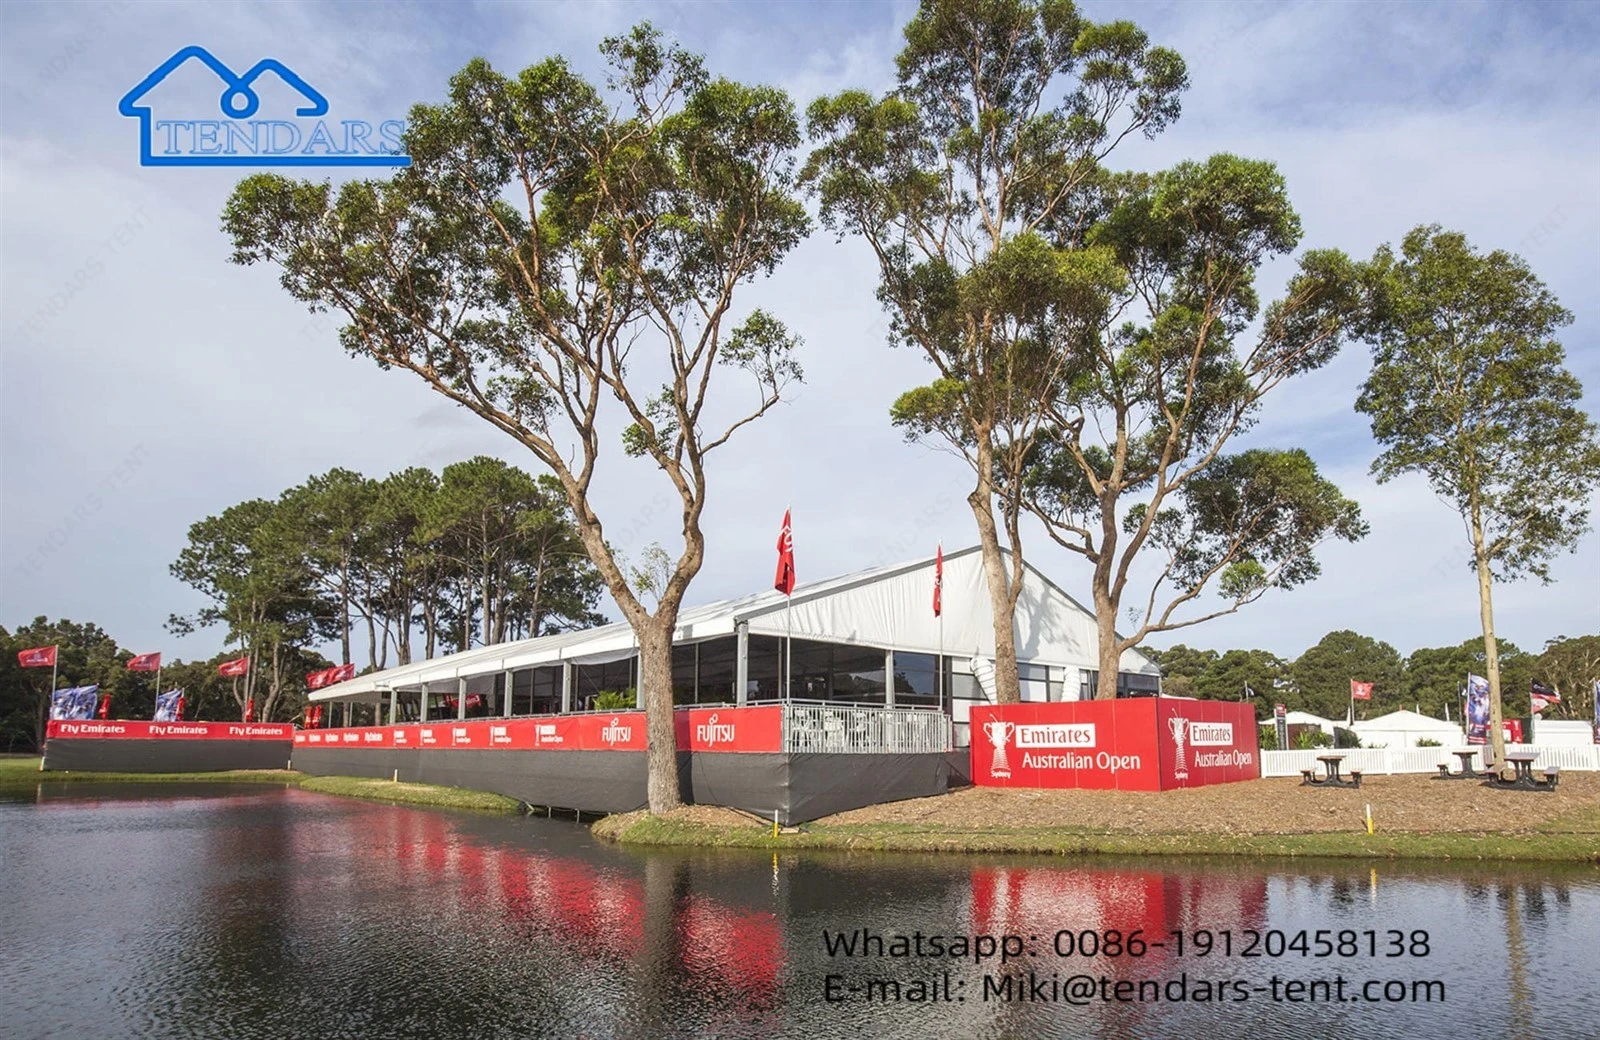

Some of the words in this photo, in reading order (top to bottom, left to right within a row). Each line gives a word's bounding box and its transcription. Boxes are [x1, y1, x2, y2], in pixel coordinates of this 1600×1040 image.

[61, 724, 80, 736] Fly
[81, 724, 126, 734] Emirates
[149, 725, 166, 736] Fly
[167, 725, 208, 735] Emirates
[229, 726, 245, 737] Fly
[246, 726, 283, 736] Emirates
[602, 725, 632, 747] FUJITSU
[697, 723, 735, 748] FUJITSU
[1020, 727, 1091, 744] Emirates
[1192, 724, 1232, 742] Emirates
[1022, 751, 1093, 769] Australian
[1096, 751, 1141, 774] Open
[1194, 750, 1232, 767] Australian
[1232, 749, 1252, 769] Open
